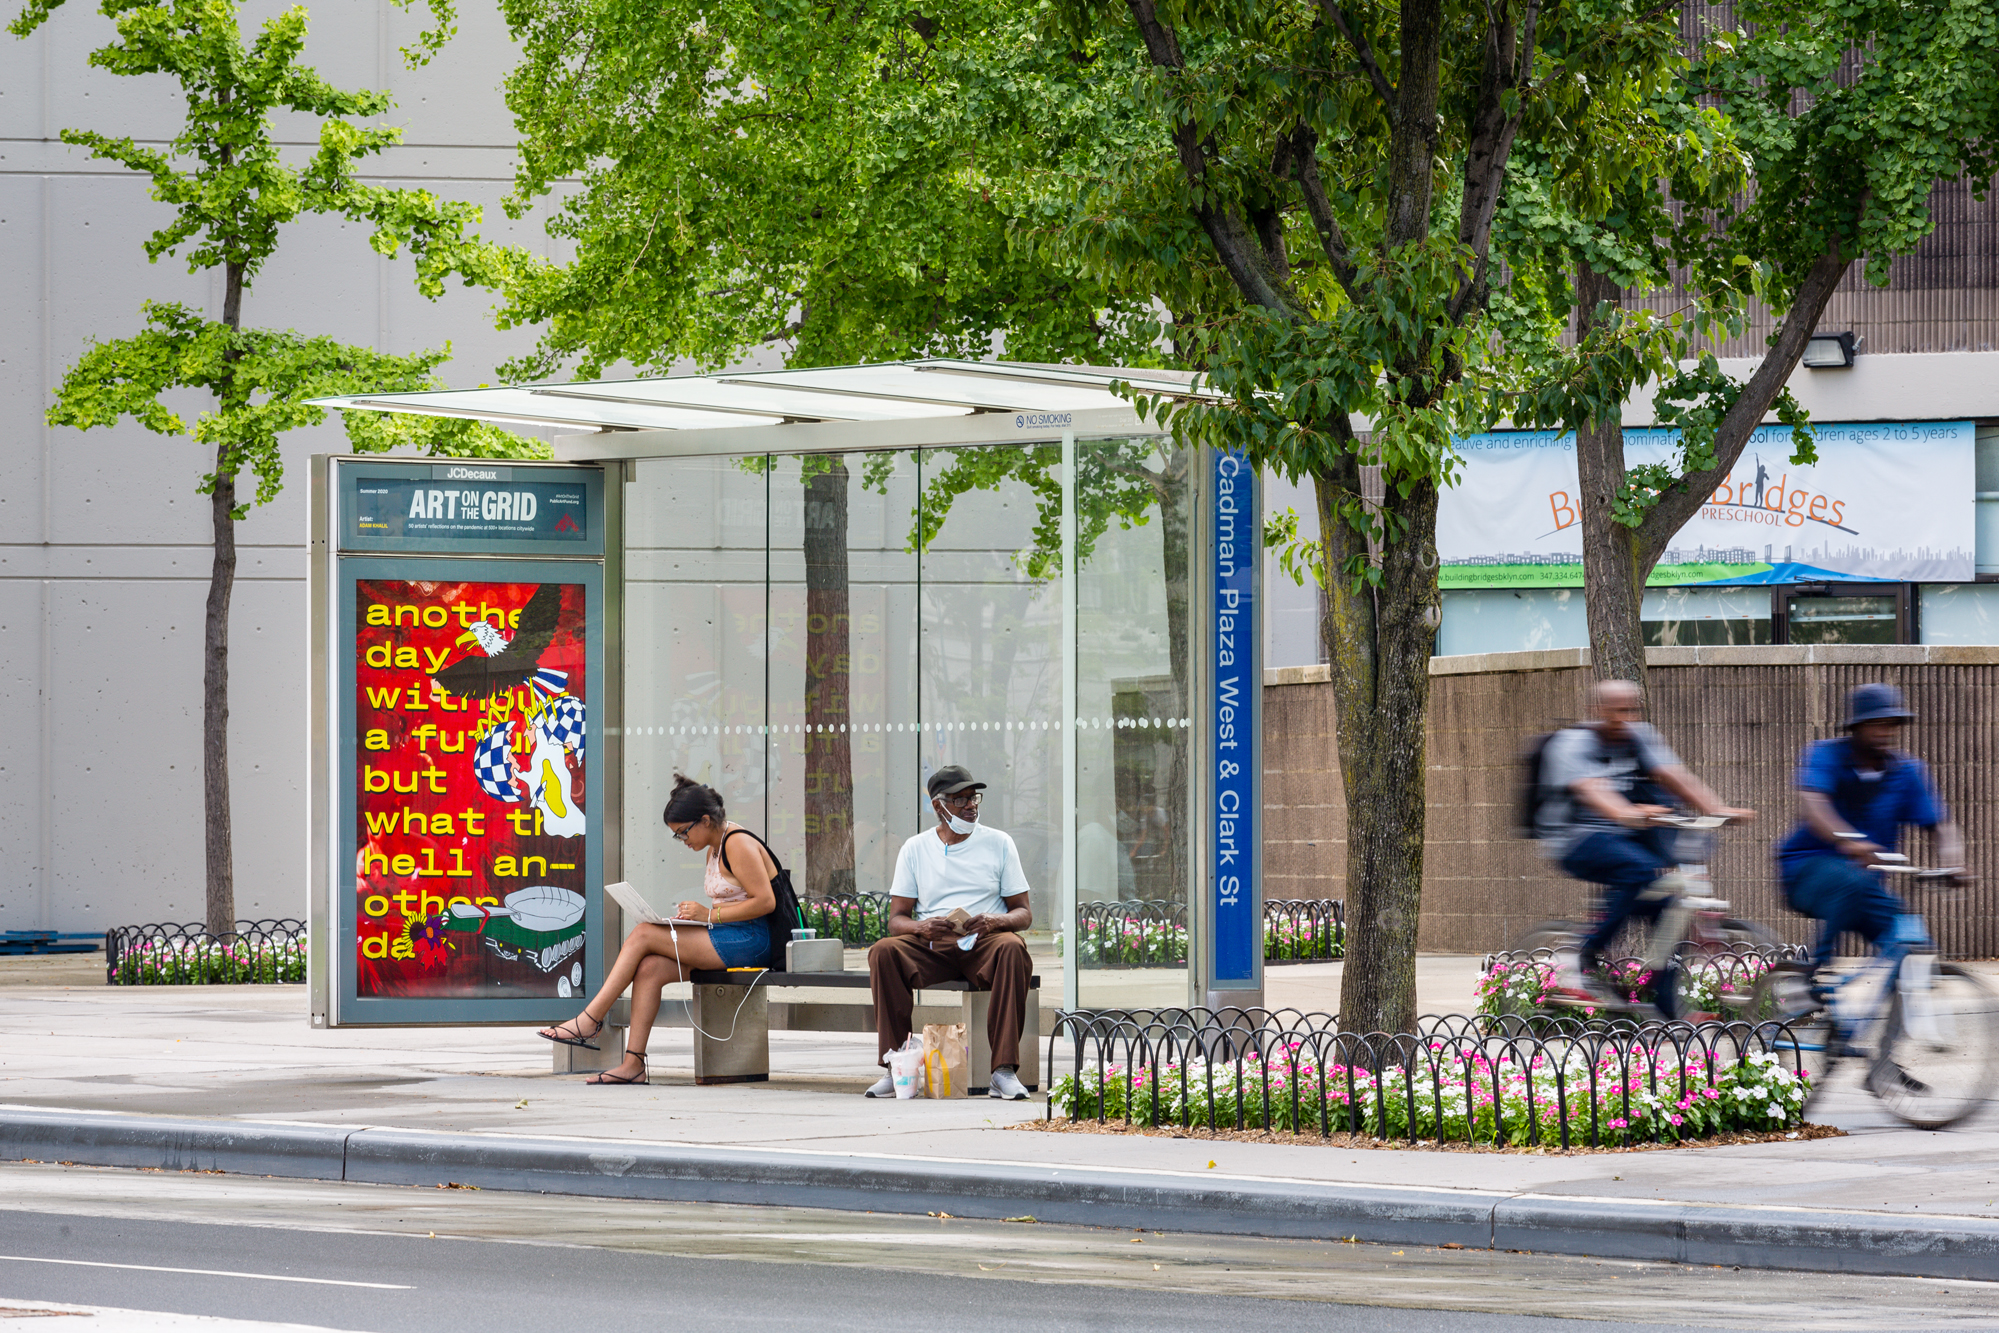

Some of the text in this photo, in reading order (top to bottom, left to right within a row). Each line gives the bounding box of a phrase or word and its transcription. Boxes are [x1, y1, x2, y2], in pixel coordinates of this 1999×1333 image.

[1026, 413, 1071, 424] NO SMOKING
[1486, 436, 1510, 449] and
[1514, 434, 1572, 450] enriching
[1772, 428, 1790, 443] for
[1849, 429, 1879, 444] ages
[1882, 427, 1891, 440] 2
[1894, 427, 1907, 441] to
[1911, 426, 1920, 440] 5
[1922, 427, 1958, 443] years
[447, 467, 497, 480] JCDecaux
[409, 489, 537, 521] ART ON THE GRID
[1701, 507, 1782, 527] PRESCHOOL
[1540, 571, 1585, 580] 347.334.647
[365, 640, 451, 674] day
[1219, 455, 1240, 906] Cadman Plaza West & Clark St
[364, 728, 391, 751] a
[364, 764, 447, 793] but
[364, 806, 485, 835] what
[364, 847, 576, 878] hell an-
[362, 931, 416, 959] da
